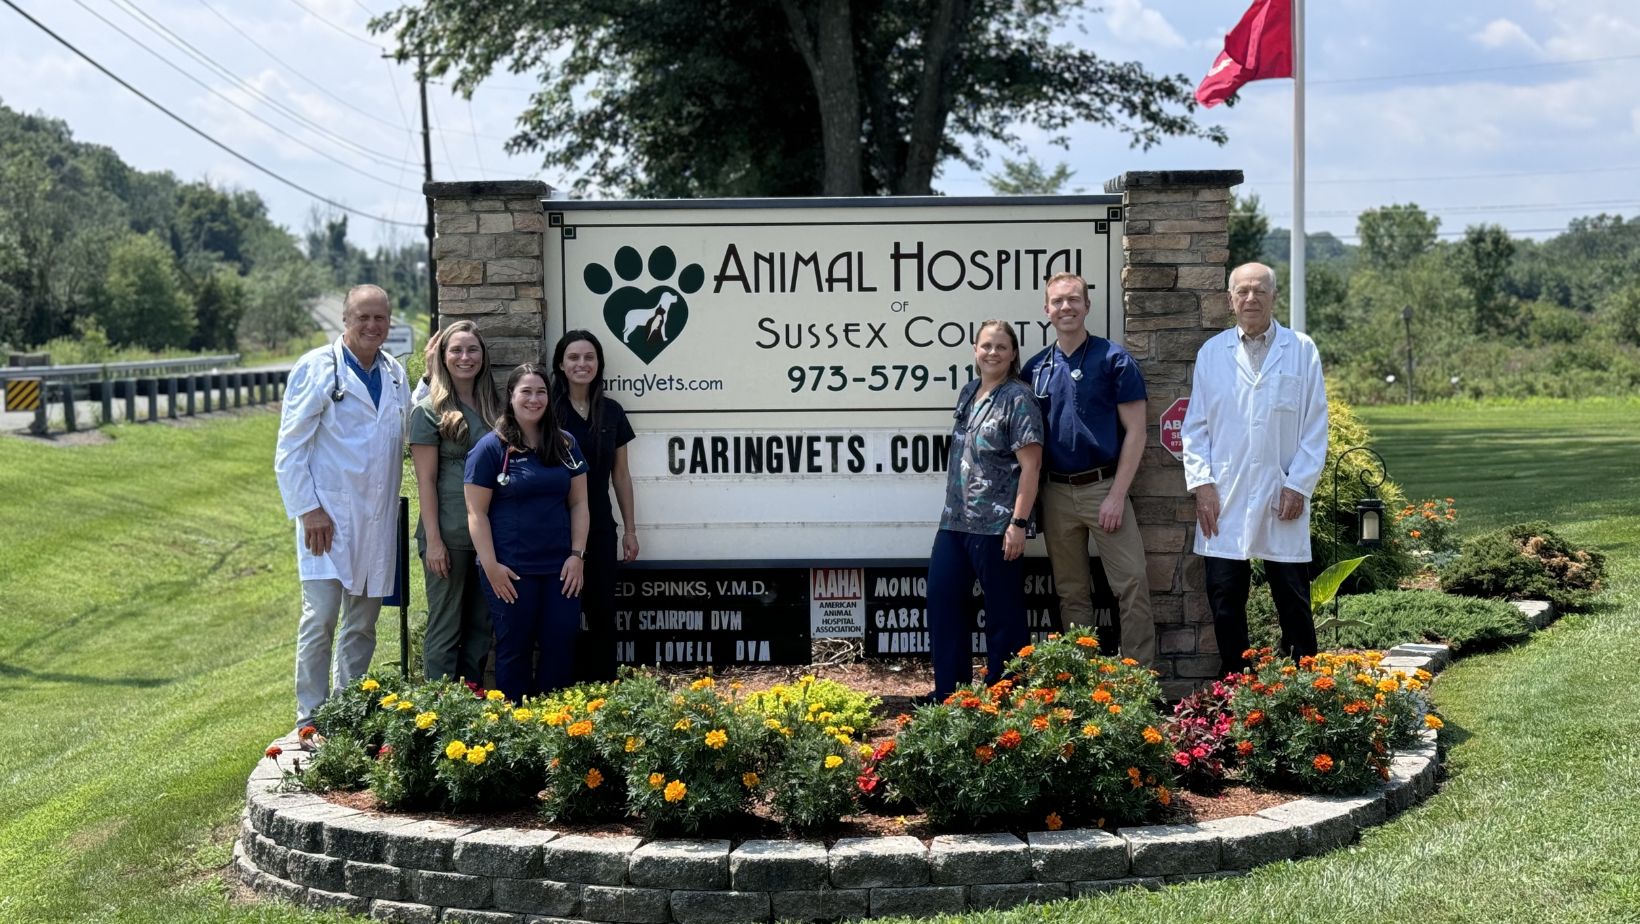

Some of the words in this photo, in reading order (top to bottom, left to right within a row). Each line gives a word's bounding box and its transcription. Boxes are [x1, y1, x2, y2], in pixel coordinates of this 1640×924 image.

[713, 243, 877, 293] ANIMAL
[890, 241, 1095, 292] HOSPITAL
[891, 301, 909, 313] OF
[755, 317, 888, 349] SUSSEX
[905, 316, 1052, 347] COTY
[787, 365, 974, 393] 973-579-11
[641, 581, 712, 599] SPINKS,
[716, 580, 769, 596] V.M.D.
[814, 569, 861, 598] AAHA
[874, 576, 928, 598] MONIQ
[819, 601, 857, 609] AMERICAN
[711, 610, 742, 631] DVM
[821, 618, 855, 626] HOSPITAL
[875, 608, 928, 629] GABRI
[656, 641, 713, 662] LOVELL
[736, 640, 771, 662] DVM
[878, 631, 931, 653] MADELE
